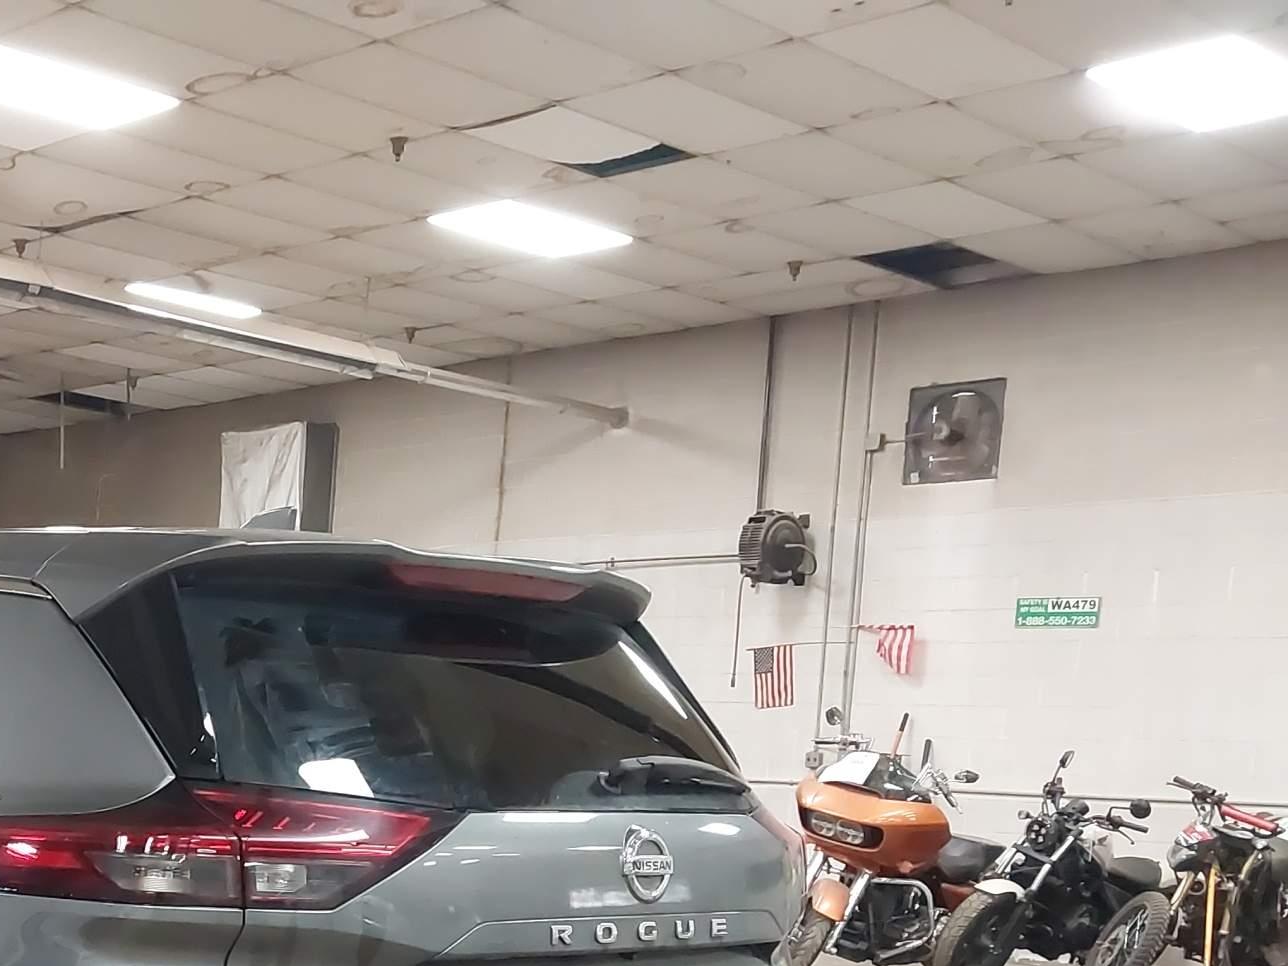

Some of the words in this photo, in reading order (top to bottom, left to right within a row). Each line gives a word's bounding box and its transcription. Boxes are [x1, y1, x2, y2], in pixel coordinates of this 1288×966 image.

[1051, 599, 1097, 611] WA479
[632, 859, 673, 872] NISSAN
[549, 917, 729, 946] ROGUE
